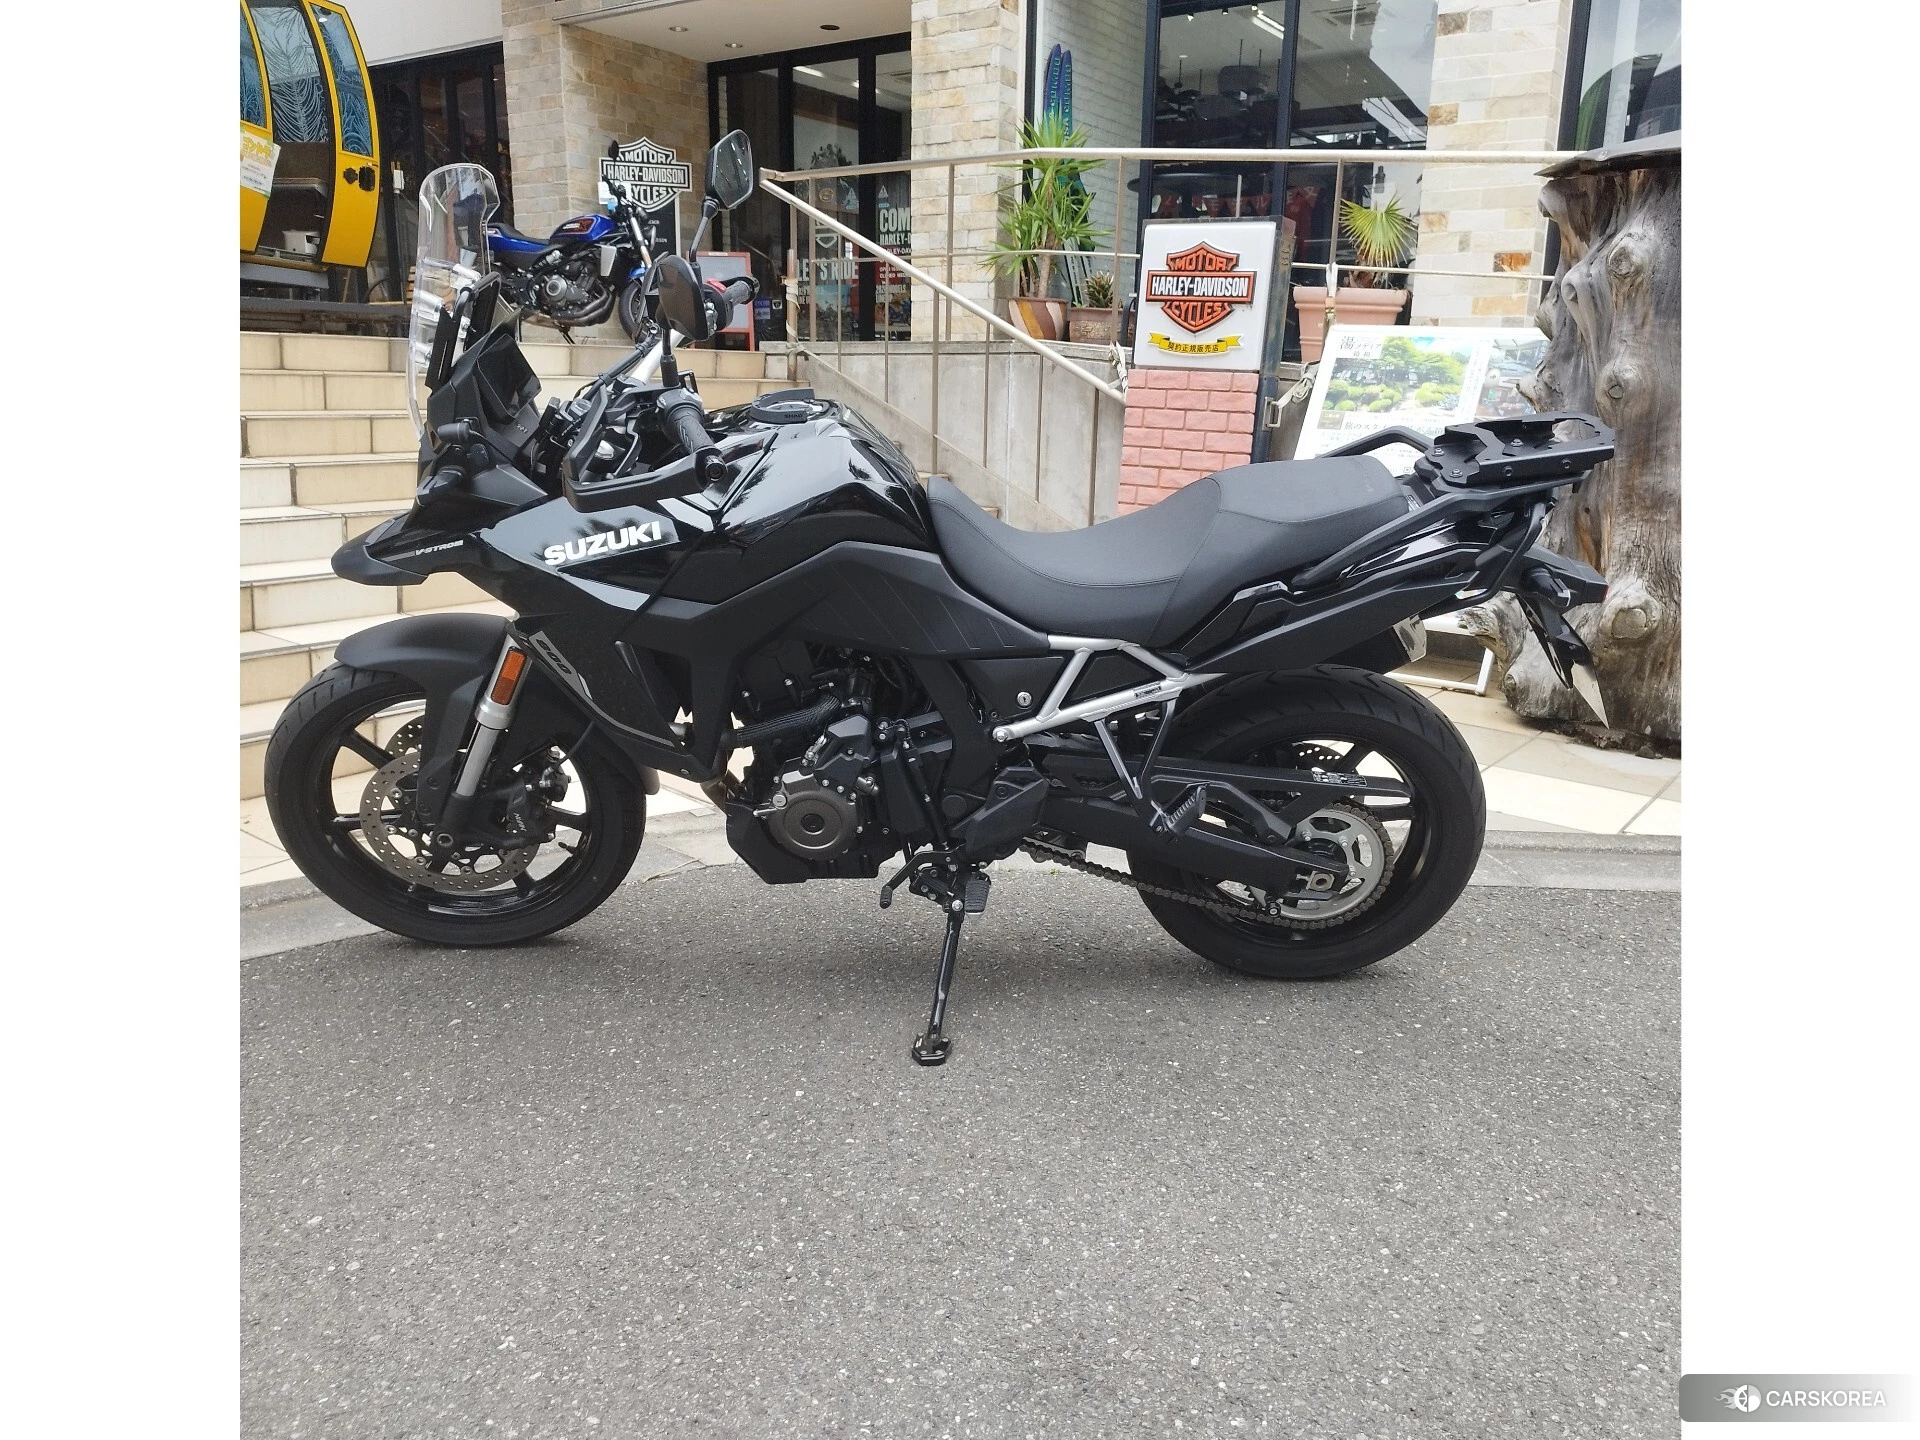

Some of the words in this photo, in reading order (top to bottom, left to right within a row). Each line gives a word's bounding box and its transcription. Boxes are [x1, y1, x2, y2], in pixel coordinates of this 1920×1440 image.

[625, 146, 667, 163] MOTOR
[607, 166, 685, 184] HARLEY-DAVIDSON
[632, 186, 666, 205] YCLES
[1174, 250, 1228, 271] MOTOR
[1151, 275, 1249, 297] HARLEY-DAVIDSON
[1171, 301, 1222, 326] CYCLES
[1167, 341, 1220, 353] 契約正規販売店
[543, 520, 662, 566] SUZUKI
[535, 638, 573, 675] 800
